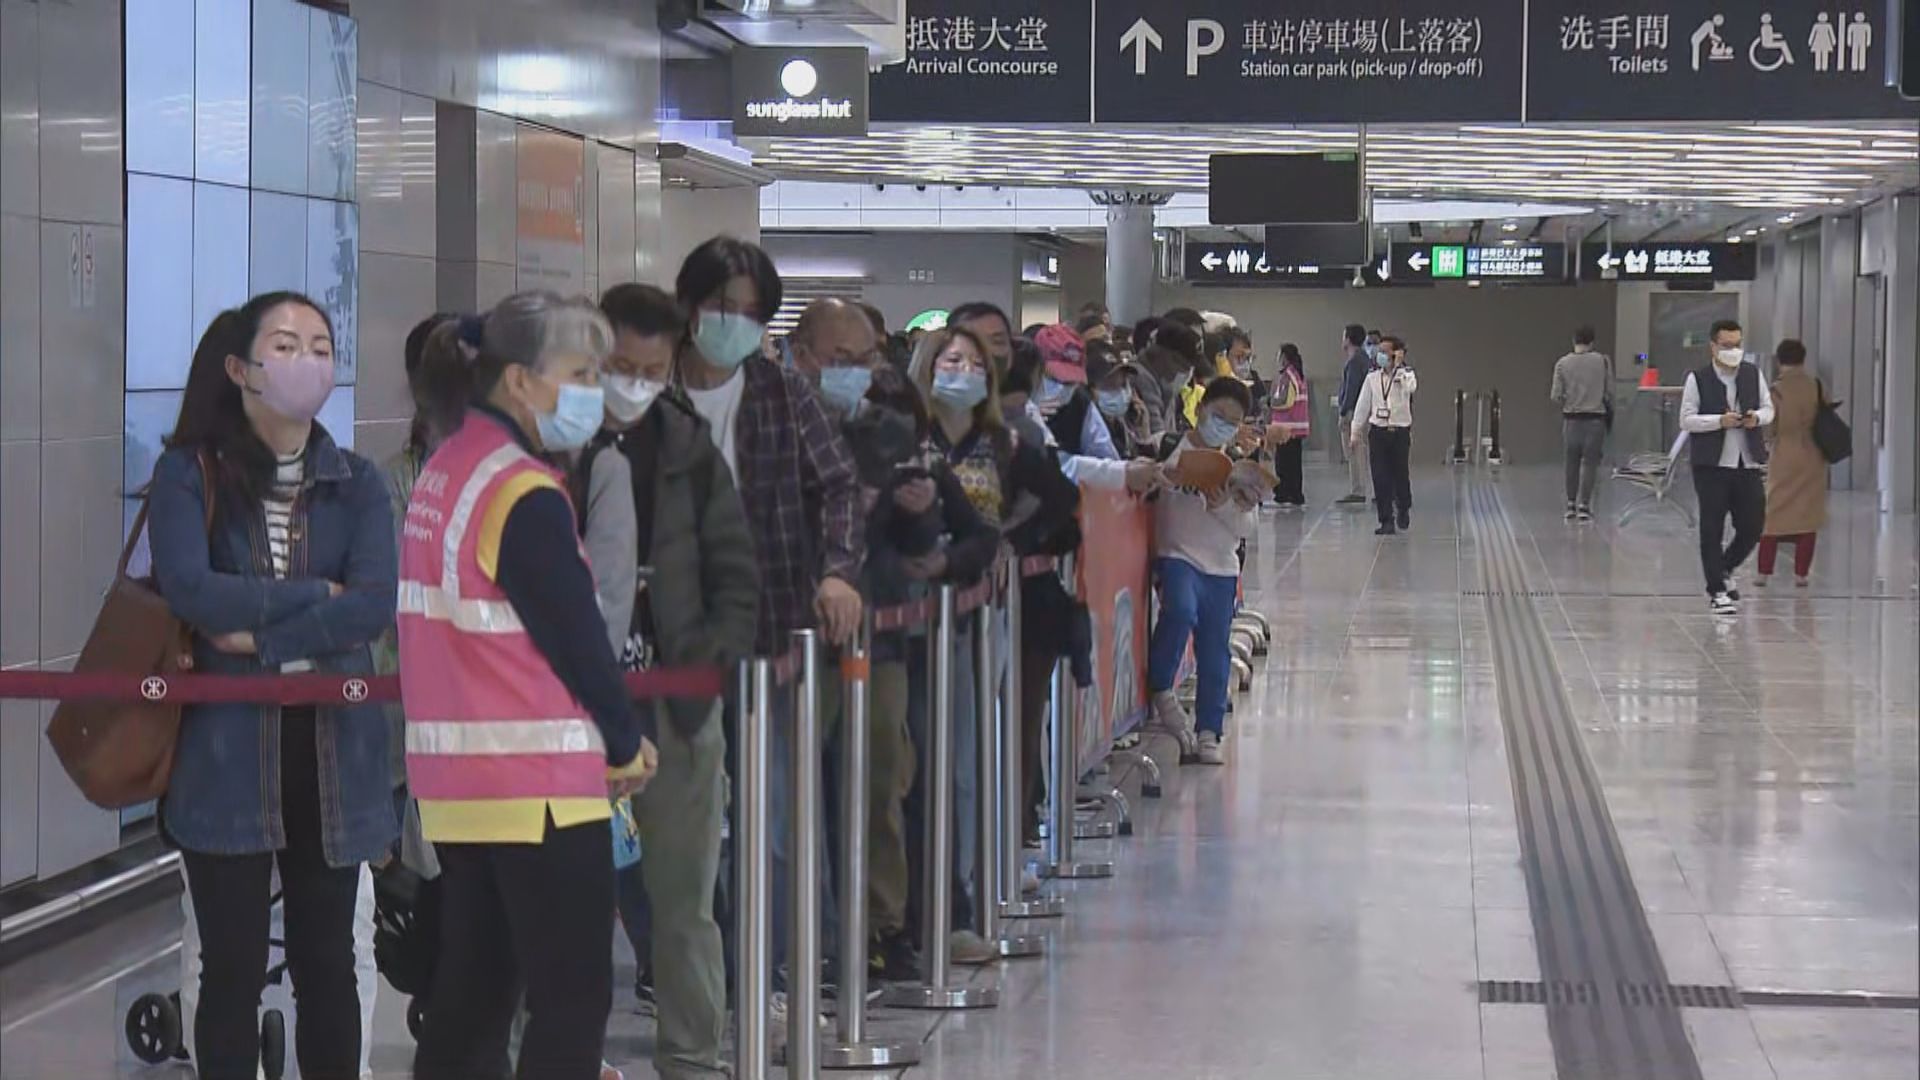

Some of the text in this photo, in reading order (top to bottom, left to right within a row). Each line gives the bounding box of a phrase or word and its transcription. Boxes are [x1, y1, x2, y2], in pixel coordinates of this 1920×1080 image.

[906, 15, 1049, 52] 抵港大堂
[1186, 19, 1225, 76] P
[1242, 17, 1482, 55] 車站停車場(上落客)
[1560, 14, 1669, 51] 洗手間
[906, 56, 1058, 75] Arrival Concourse
[1241, 59, 1290, 77] Station
[1292, 63, 1315, 77] car
[1316, 59, 1348, 79] park
[1350, 57, 1408, 80] (pick-up
[1418, 57, 1483, 80] drop-off)
[1608, 54, 1669, 74] Toilets
[746, 97, 852, 123] sunglass hut
